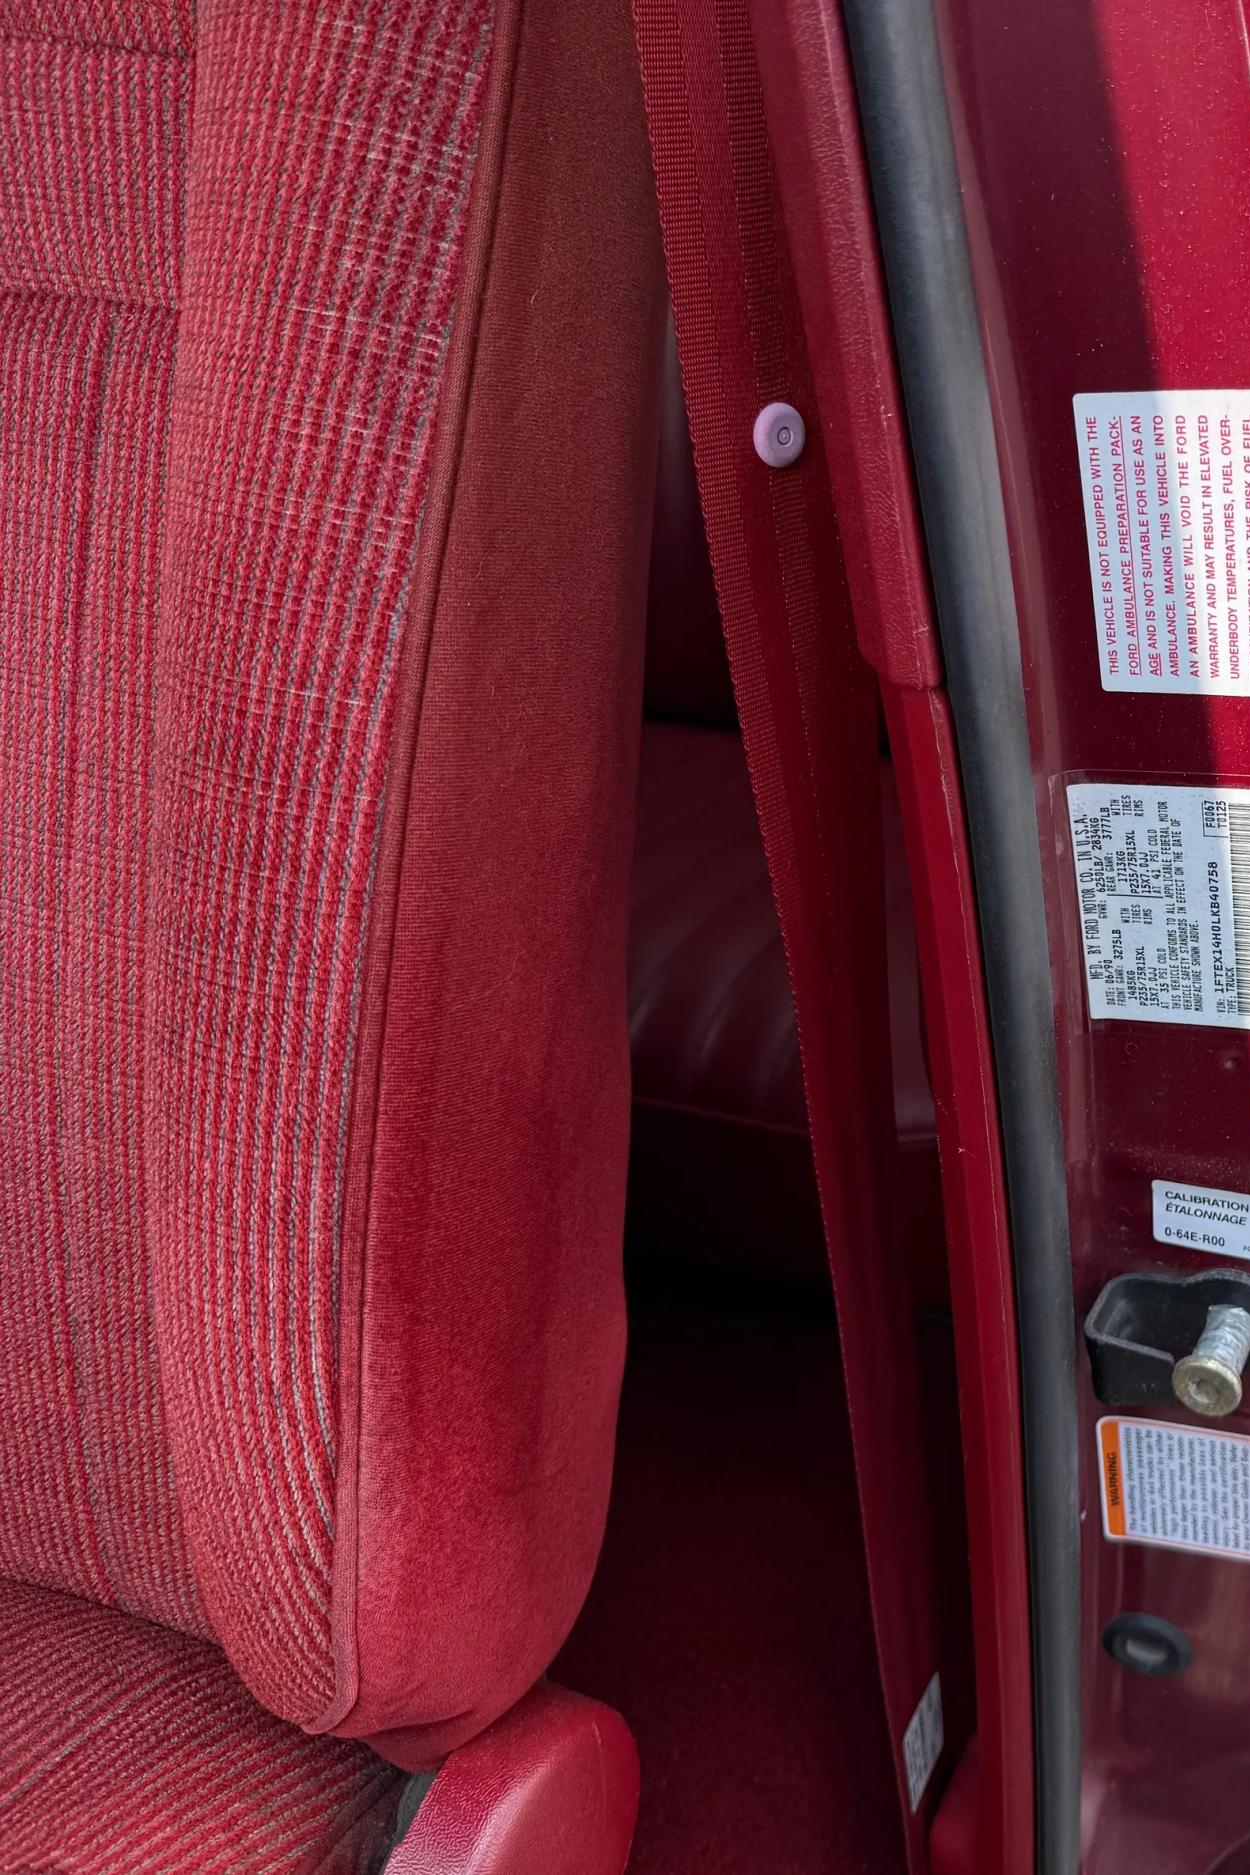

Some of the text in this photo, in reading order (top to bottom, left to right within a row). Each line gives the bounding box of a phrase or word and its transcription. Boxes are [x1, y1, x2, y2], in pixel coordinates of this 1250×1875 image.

[1086, 416, 1119, 674] THIS VEHICLE IS NOT EQUIPPED WITH THE
[1109, 415, 1139, 675] FORD AMBULANCE PREPARATION PACK-
[1131, 415, 1159, 675] AGE AND IS NOT SUITABLE FOR USE AS AN
[1154, 415, 1179, 676] AMBULANCE. MAKING THIS VEHICLE INTO
[1176, 415, 1199, 677] AN AMBULANCE WILL VOID THE FORD
[1199, 414, 1219, 678] WARRANTY AND MAY RESULT IN ELEVATED
[1220, 414, 1239, 678] UNDERBODY TEMPERATURES, FUEL OVER-
[1100, 806, 1116, 892] REAR GAWR: 3777LB
[1110, 798, 1127, 882] 1713KG WITH
[1122, 794, 1139, 893] P235/75R15XL TIRES
[1134, 799, 1143, 816] RIMS
[1073, 813, 1104, 979] MFD. BY FORD MOTOR CO. IN U.S.A.
[1089, 817, 1108, 919] GVWR: 6250LB/ 2834KG
[1148, 829, 1161, 894] AT 41 PSI COLD
[1158, 800, 1182, 1009] THIS VEHICLE CONFORMS TO ALL APPLICABLE FEDERAL MOTOR
[1120, 907, 1130, 923] WITH
[1131, 903, 1149, 1006] P235/75R15XL TIRES
[1143, 908, 1152, 924] RIMS
[1171, 817, 1193, 1010] VEHICLE SAFETY STANDARDS IN EFFECT ON THE DATE OF
[1103, 958, 1116, 1005] DATE: 06/90
[1111, 928, 1127, 1006] FRONT GAWR: 3275LB
[1157, 947, 1170, 1009] AT 35 PSI COLD
[1189, 919, 1203, 1011] MANUFACTURE SHOWN ABOVE.
[1216, 997, 1226, 1013] VIN:
[1225, 966, 1236, 1013] TYPE: TRUCK
[1165, 1190, 1249, 1212] CALIBRATION
[1165, 1201, 1246, 1226] ÉTALONNAGE
[1107, 1450, 1120, 1506] WARNING
[1123, 1426, 1134, 1481] characteristics
